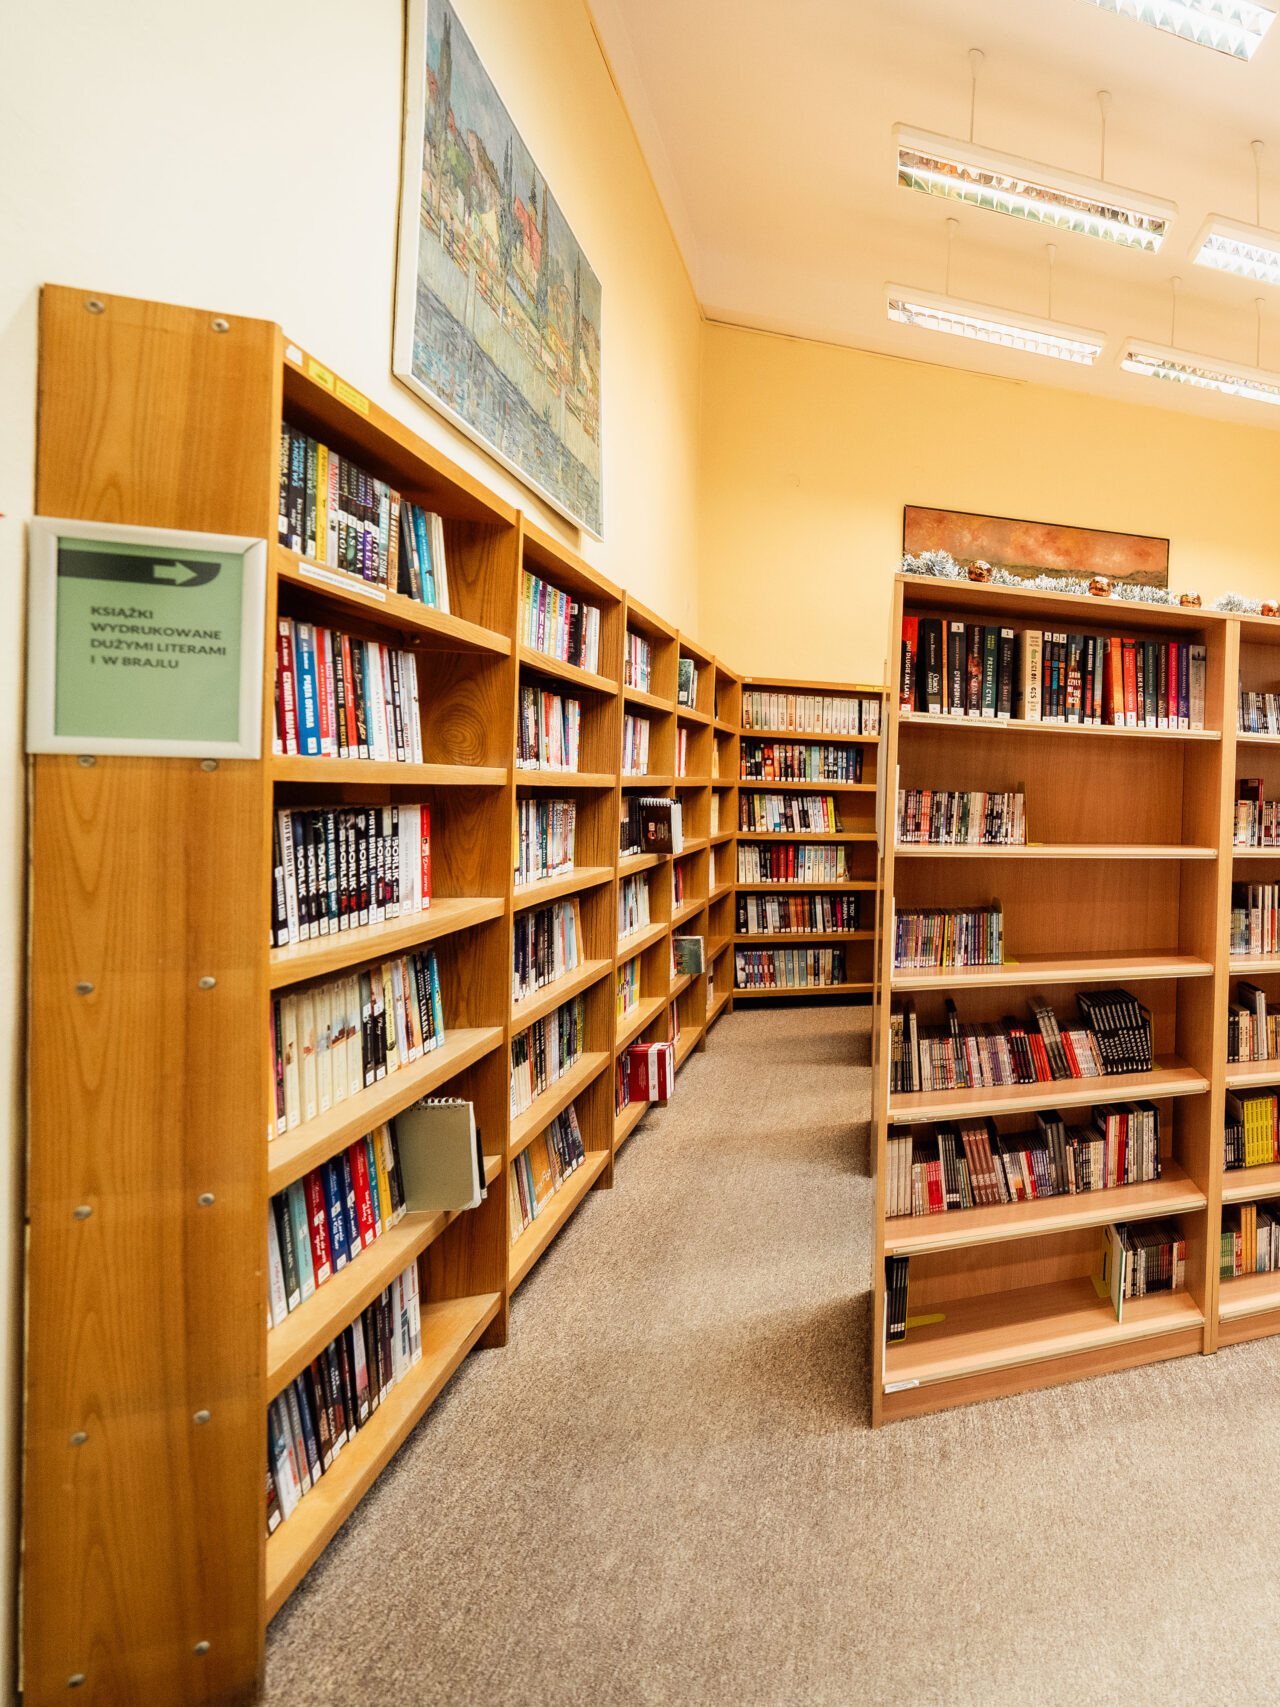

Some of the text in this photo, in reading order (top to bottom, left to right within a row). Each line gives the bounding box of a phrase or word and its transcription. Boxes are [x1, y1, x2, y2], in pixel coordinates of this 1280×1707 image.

[90, 605, 153, 621] KSIĄŻKI
[90, 623, 222, 641] WYDRUKOWANE
[90, 637, 226, 657] DUŻYMI LITERAMI
[90, 655, 180, 670] I W BRAJLU
[282, 671, 293, 711] CZWARTA
[303, 674, 315, 729] PIĄTA OFIARA
